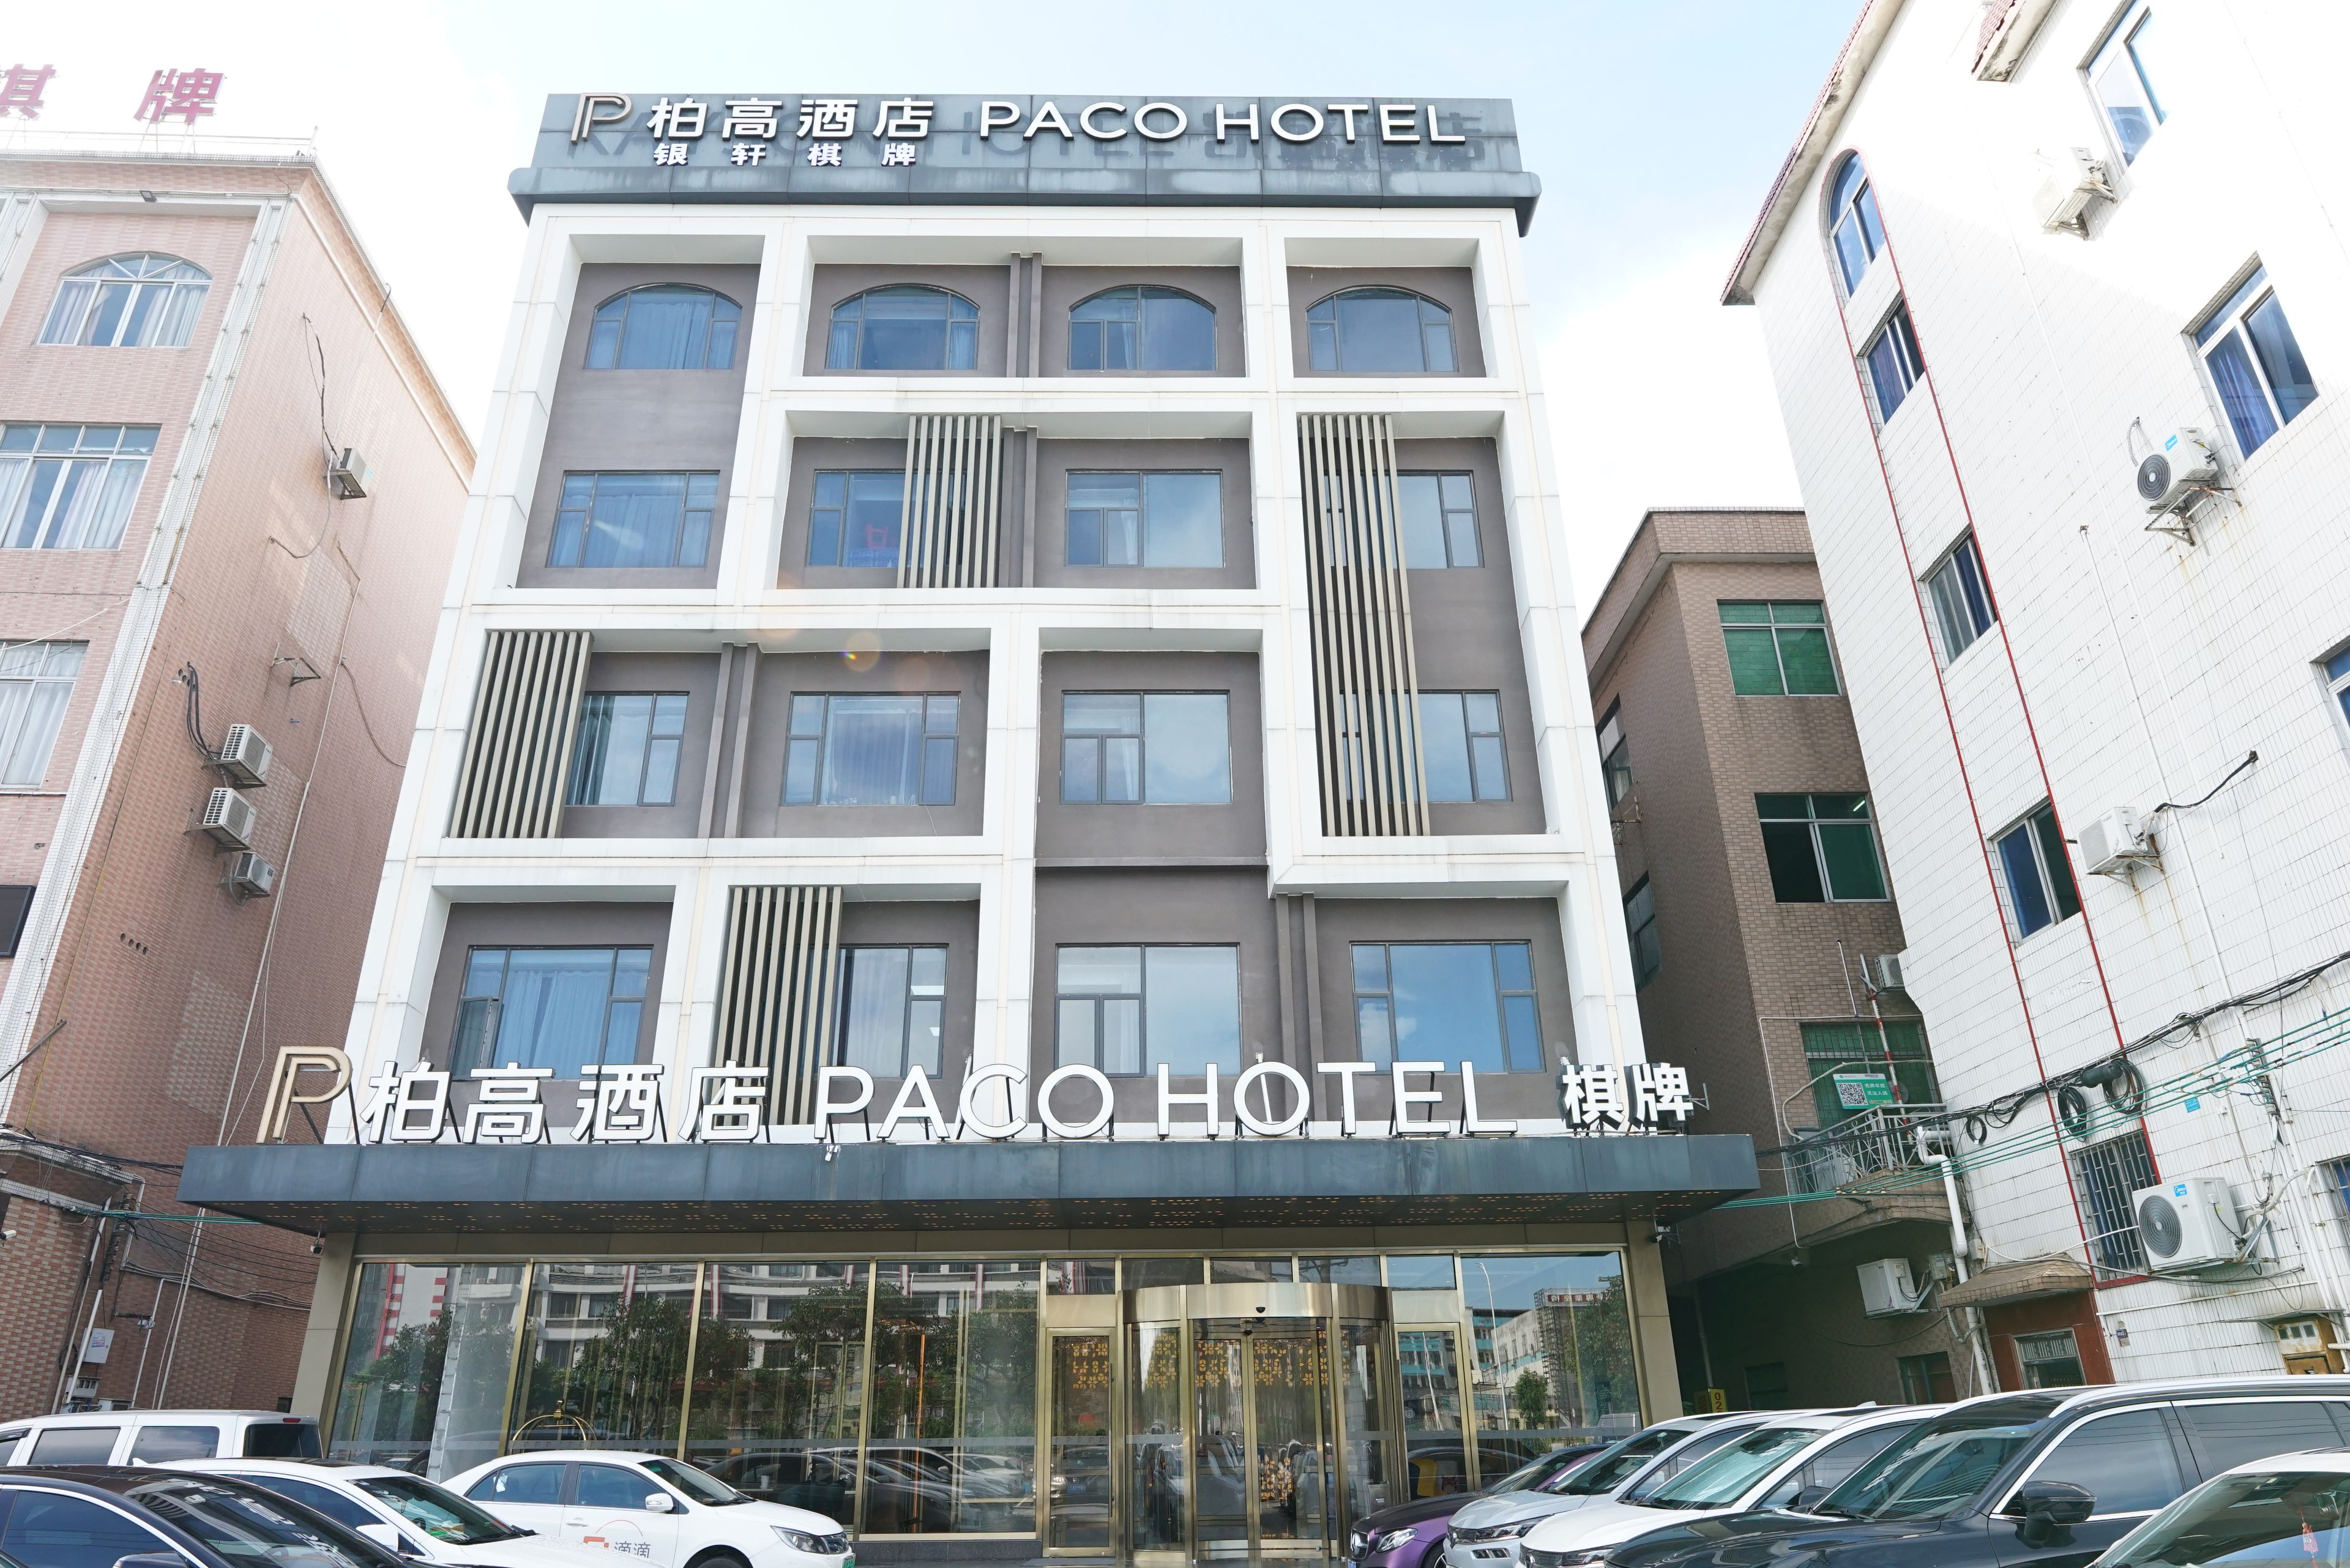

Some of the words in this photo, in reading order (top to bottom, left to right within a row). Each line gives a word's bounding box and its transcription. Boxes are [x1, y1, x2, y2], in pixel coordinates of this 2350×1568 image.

[646, 97, 934, 141] 柏高酒店
[980, 100, 1187, 143] PACO
[1215, 103, 1466, 145] HOTEL
[654, 143, 916, 166] 银轩棋牌
[360, 1060, 770, 1144] 柏高酒店
[814, 1063, 1114, 1139] PACO
[1157, 1061, 1517, 1136] HOTEL
[1559, 1062, 1695, 1129] 棋牌
[1714, 1392, 1723, 1413] 02
